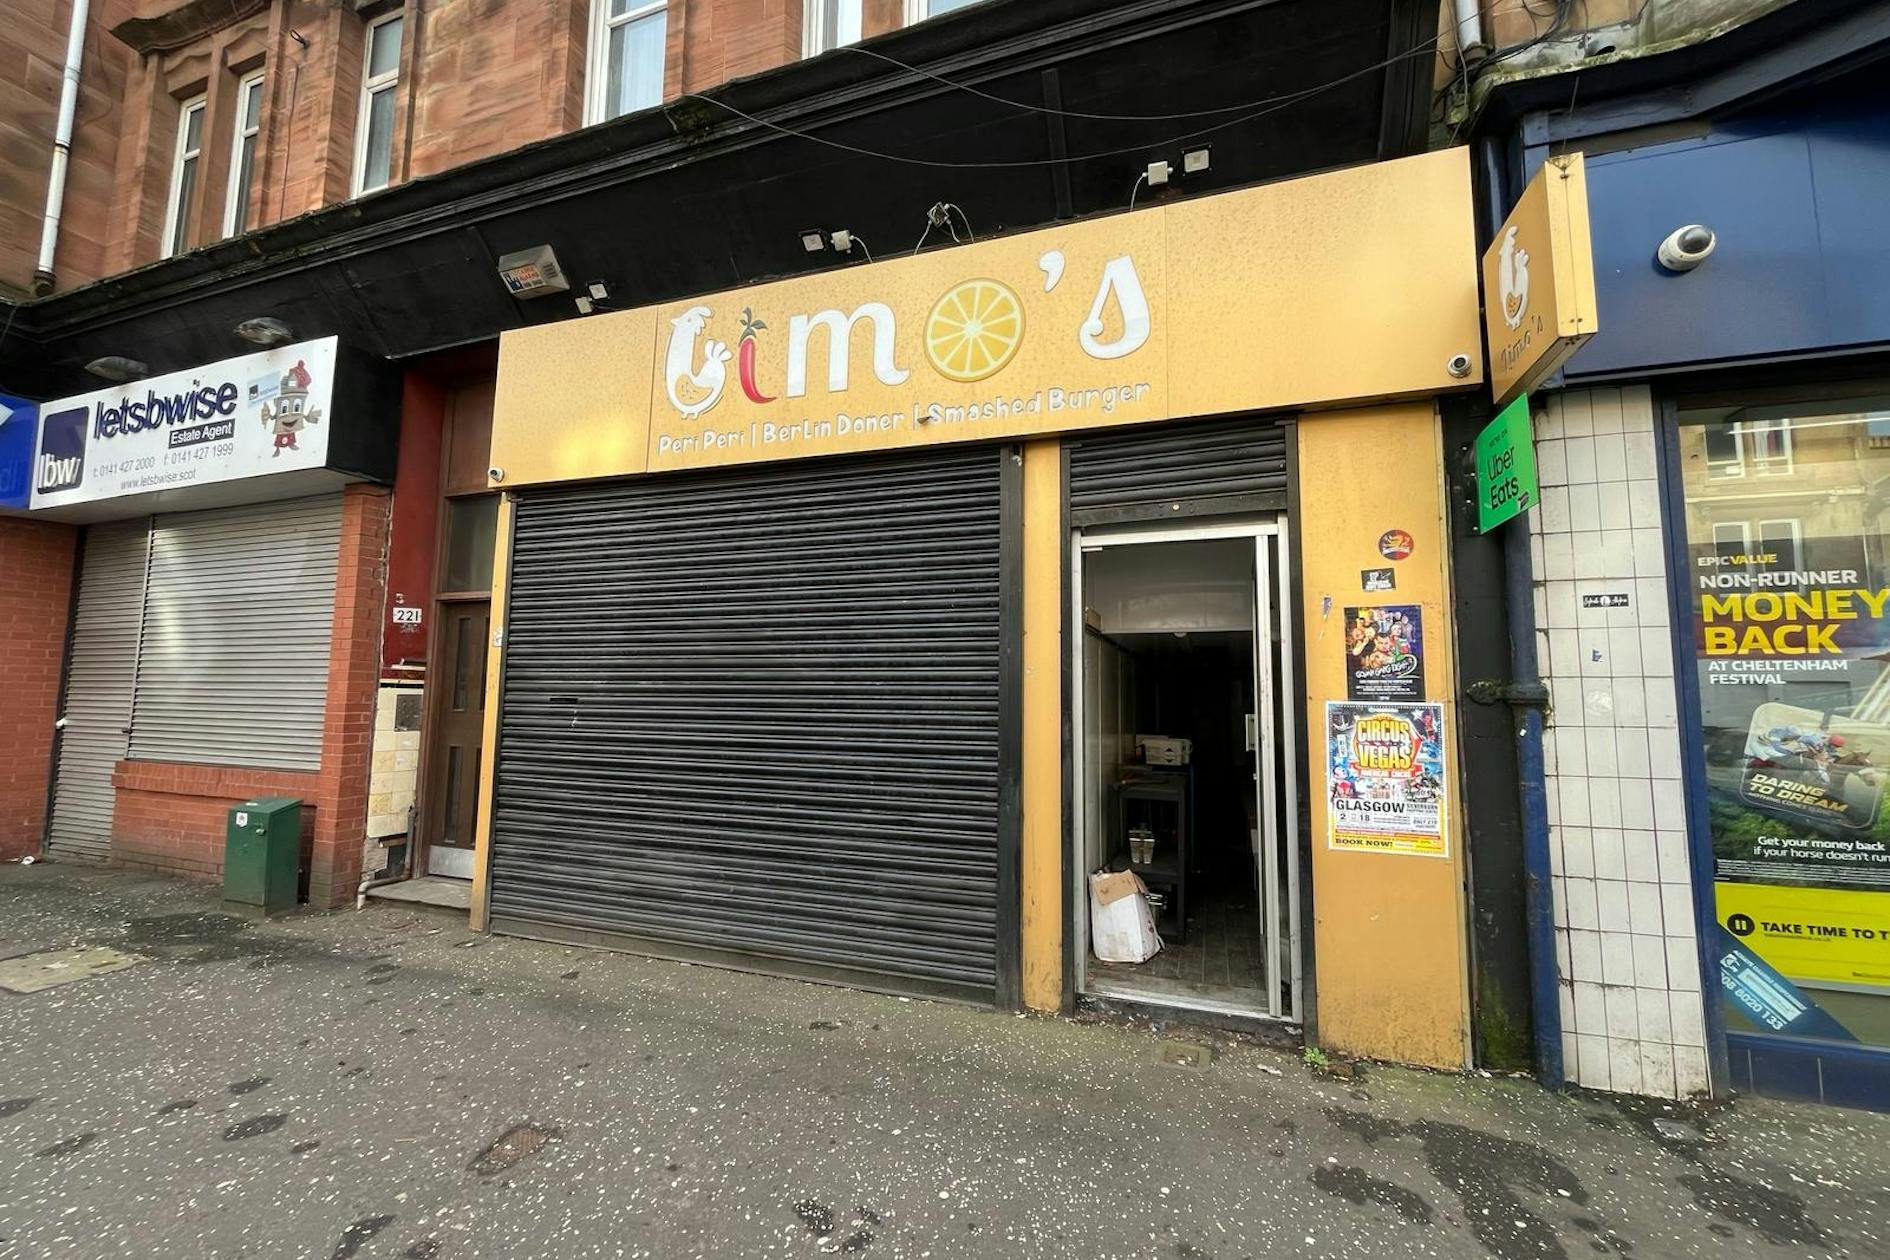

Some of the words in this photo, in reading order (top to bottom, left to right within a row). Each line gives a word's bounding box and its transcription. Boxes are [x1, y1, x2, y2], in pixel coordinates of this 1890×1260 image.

[93, 381, 238, 440] letsbwise
[658, 434, 698, 456] Peri
[703, 429, 744, 449] Peri
[836, 411, 905, 437] Doner
[929, 392, 1041, 424] Smashed
[1048, 382, 1151, 413] Burger
[170, 428, 200, 445] Estate
[202, 421, 232, 441] Agent
[99, 463, 118, 476] 0141
[119, 460, 133, 473] 427
[135, 457, 155, 470] 2000
[171, 451, 191, 465] 0141
[193, 447, 209, 460] 427
[212, 442, 234, 457] 1999
[1488, 446, 1514, 481] Uber
[1490, 476, 1519, 509] Eats
[1699, 570, 1858, 588] NON-RUNNER
[397, 610, 419, 621] 221
[1701, 588, 1890, 622] MONEY
[1704, 624, 1843, 655] BACK
[1708, 660, 1729, 671] AT
[1732, 659, 1848, 671] CHELTENHAM
[1710, 674, 1786, 685] FESTIVAL
[1357, 720, 1410, 743] CIRCUS
[1359, 744, 1412, 769] VEGAS
[1752, 773, 1826, 796] DARING
[1336, 799, 1405, 813] GLASGOW
[1750, 783, 1774, 795] TO
[1776, 790, 1849, 812] DREAM
[1753, 846, 1761, 855] if
[1763, 848, 1788, 857] your
[1791, 848, 1823, 858] horse
[1826, 851, 1869, 861] doesn't
[1757, 836, 1778, 846] Get
[1781, 838, 1808, 848] your
[1812, 840, 1853, 851] money
[1856, 841, 1885, 851] back
[1761, 922, 1802, 934] TAKE
[1807, 925, 1847, 937] TIME
[1852, 929, 1875, 940] TO
[1762, 1009, 1785, 1031] 133
